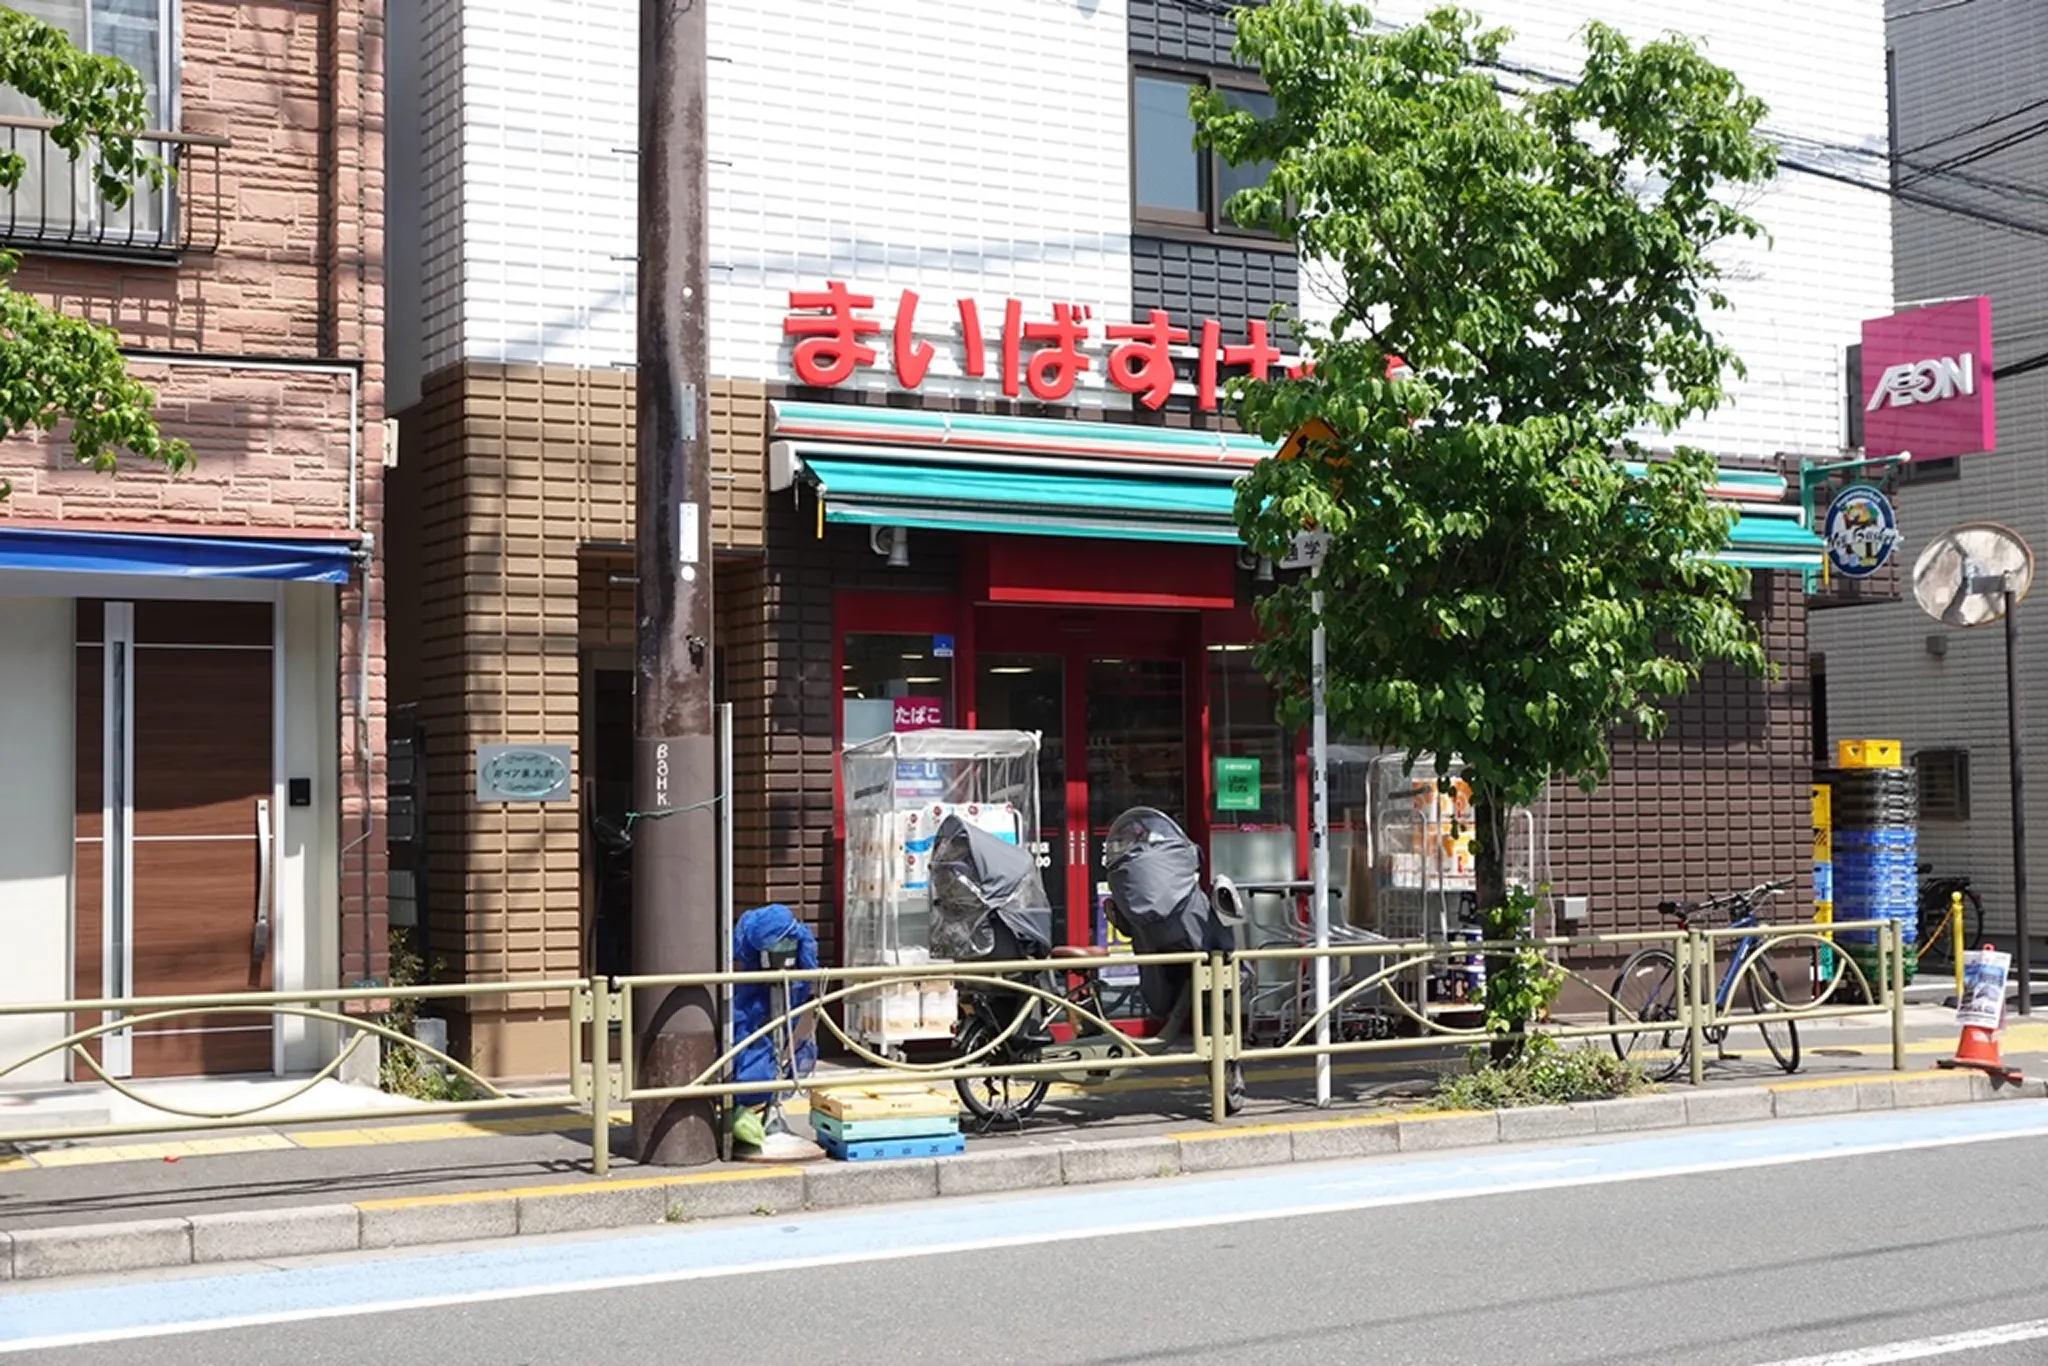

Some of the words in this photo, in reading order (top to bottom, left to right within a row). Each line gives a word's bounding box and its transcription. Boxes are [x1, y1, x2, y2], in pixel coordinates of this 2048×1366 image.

[783, 280, 1407, 412] まいばすけ
[1865, 352, 1973, 412] AEON
[895, 706, 941, 725] たばこ
